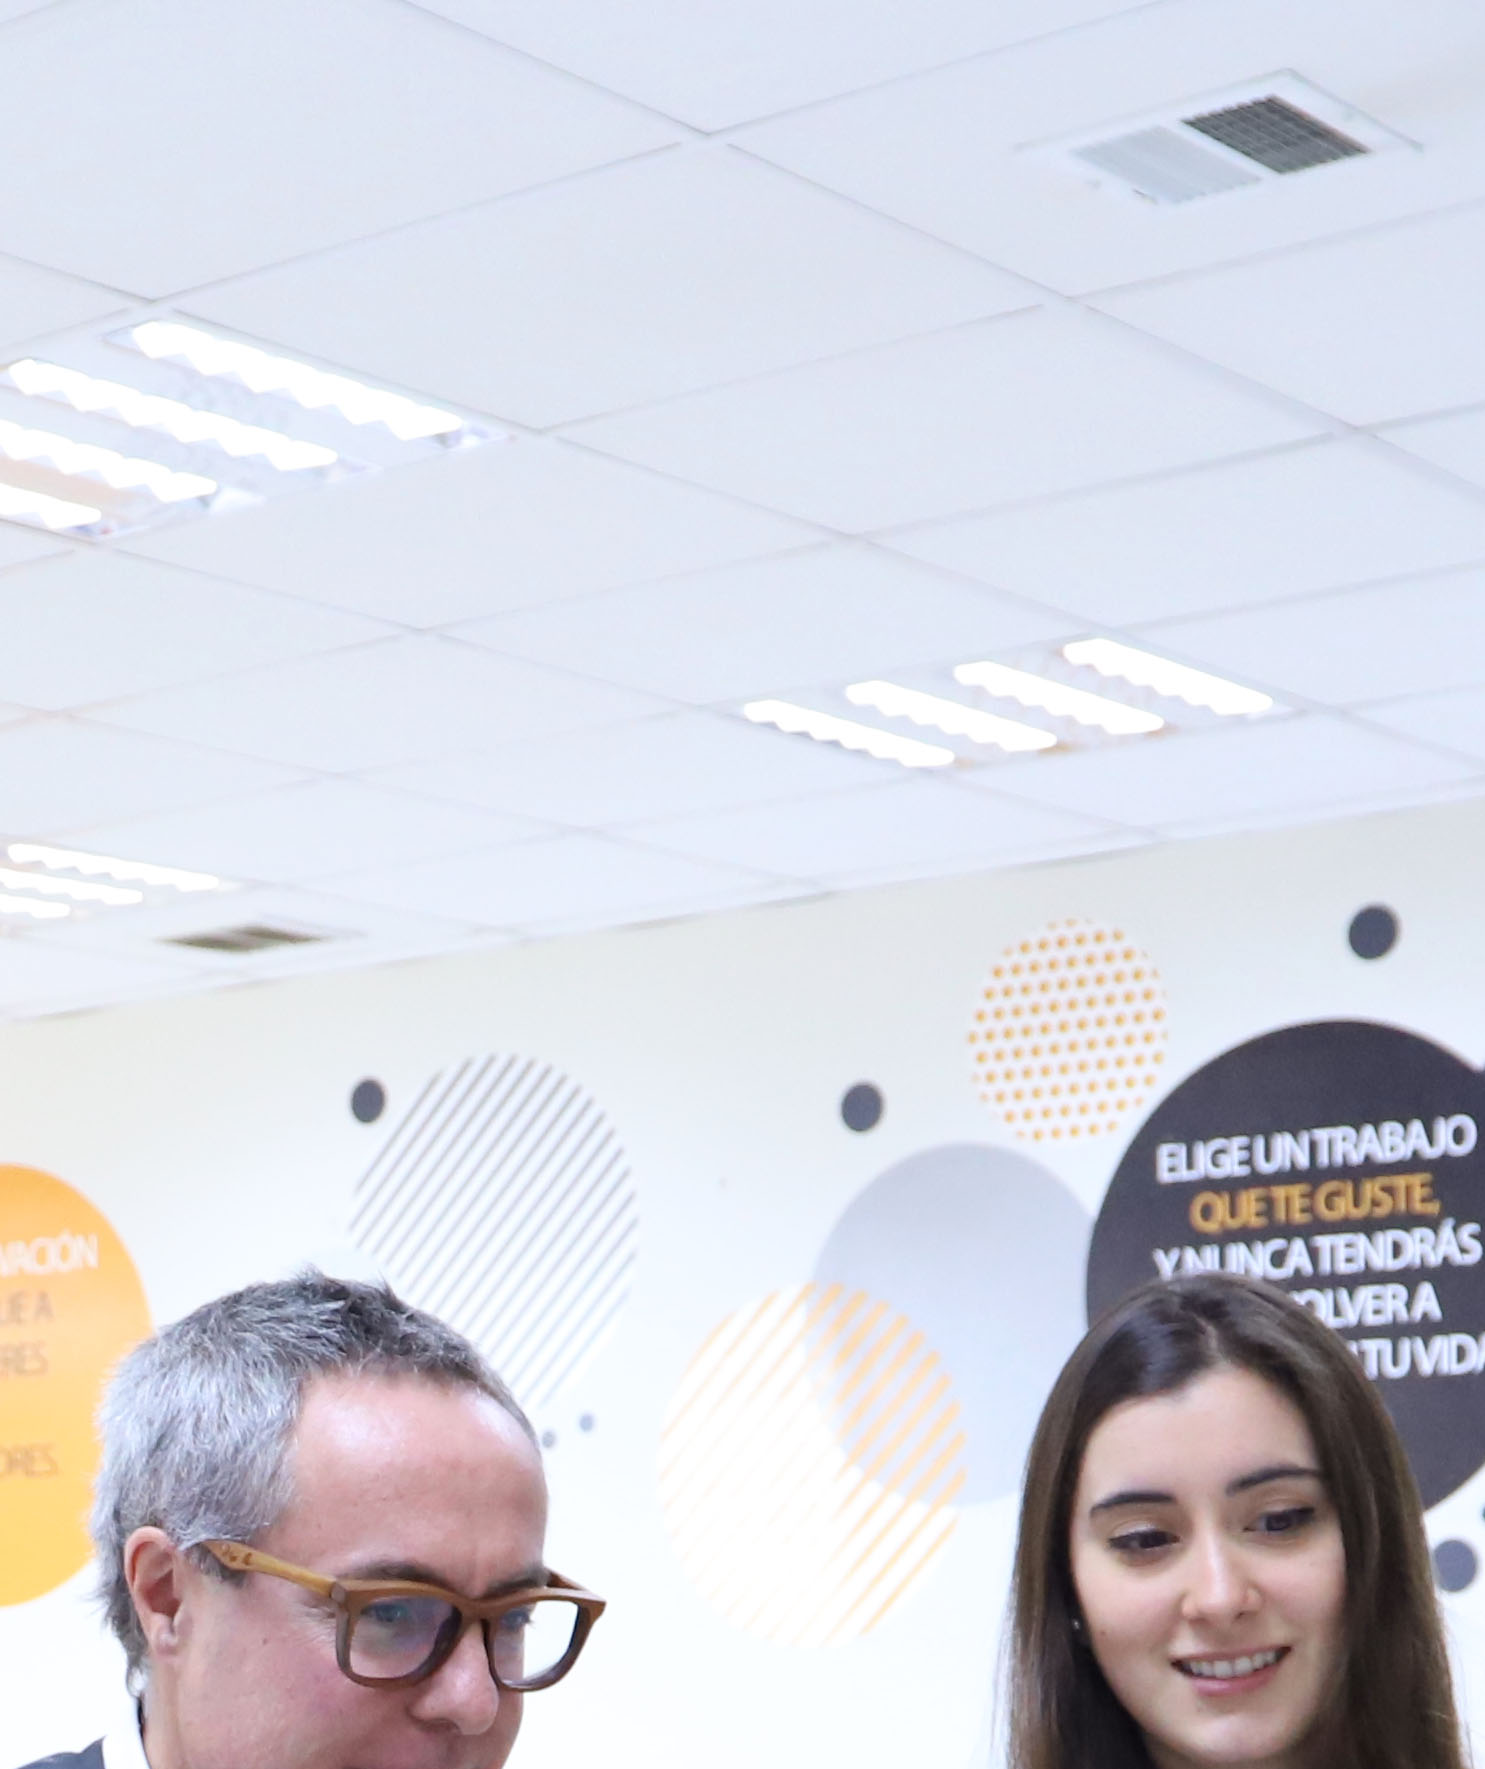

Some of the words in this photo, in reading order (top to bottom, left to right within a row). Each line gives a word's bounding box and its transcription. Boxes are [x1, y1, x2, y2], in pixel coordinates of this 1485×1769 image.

[1155, 1135, 1251, 1184] ELIGE
[1251, 1129, 1310, 1174] UN
[1309, 1113, 1478, 1169] TRABAJO
[1189, 1187, 1270, 1235] QUE
[1270, 1182, 1313, 1225] TE
[1313, 1172, 1442, 1221] GUSTE,
[1152, 1247, 1180, 1280] Y
[1181, 1237, 1314, 1280] NUNCA
[1310, 1217, 1483, 1276] TENDRÁS
[1409, 1280, 1442, 1323] A
